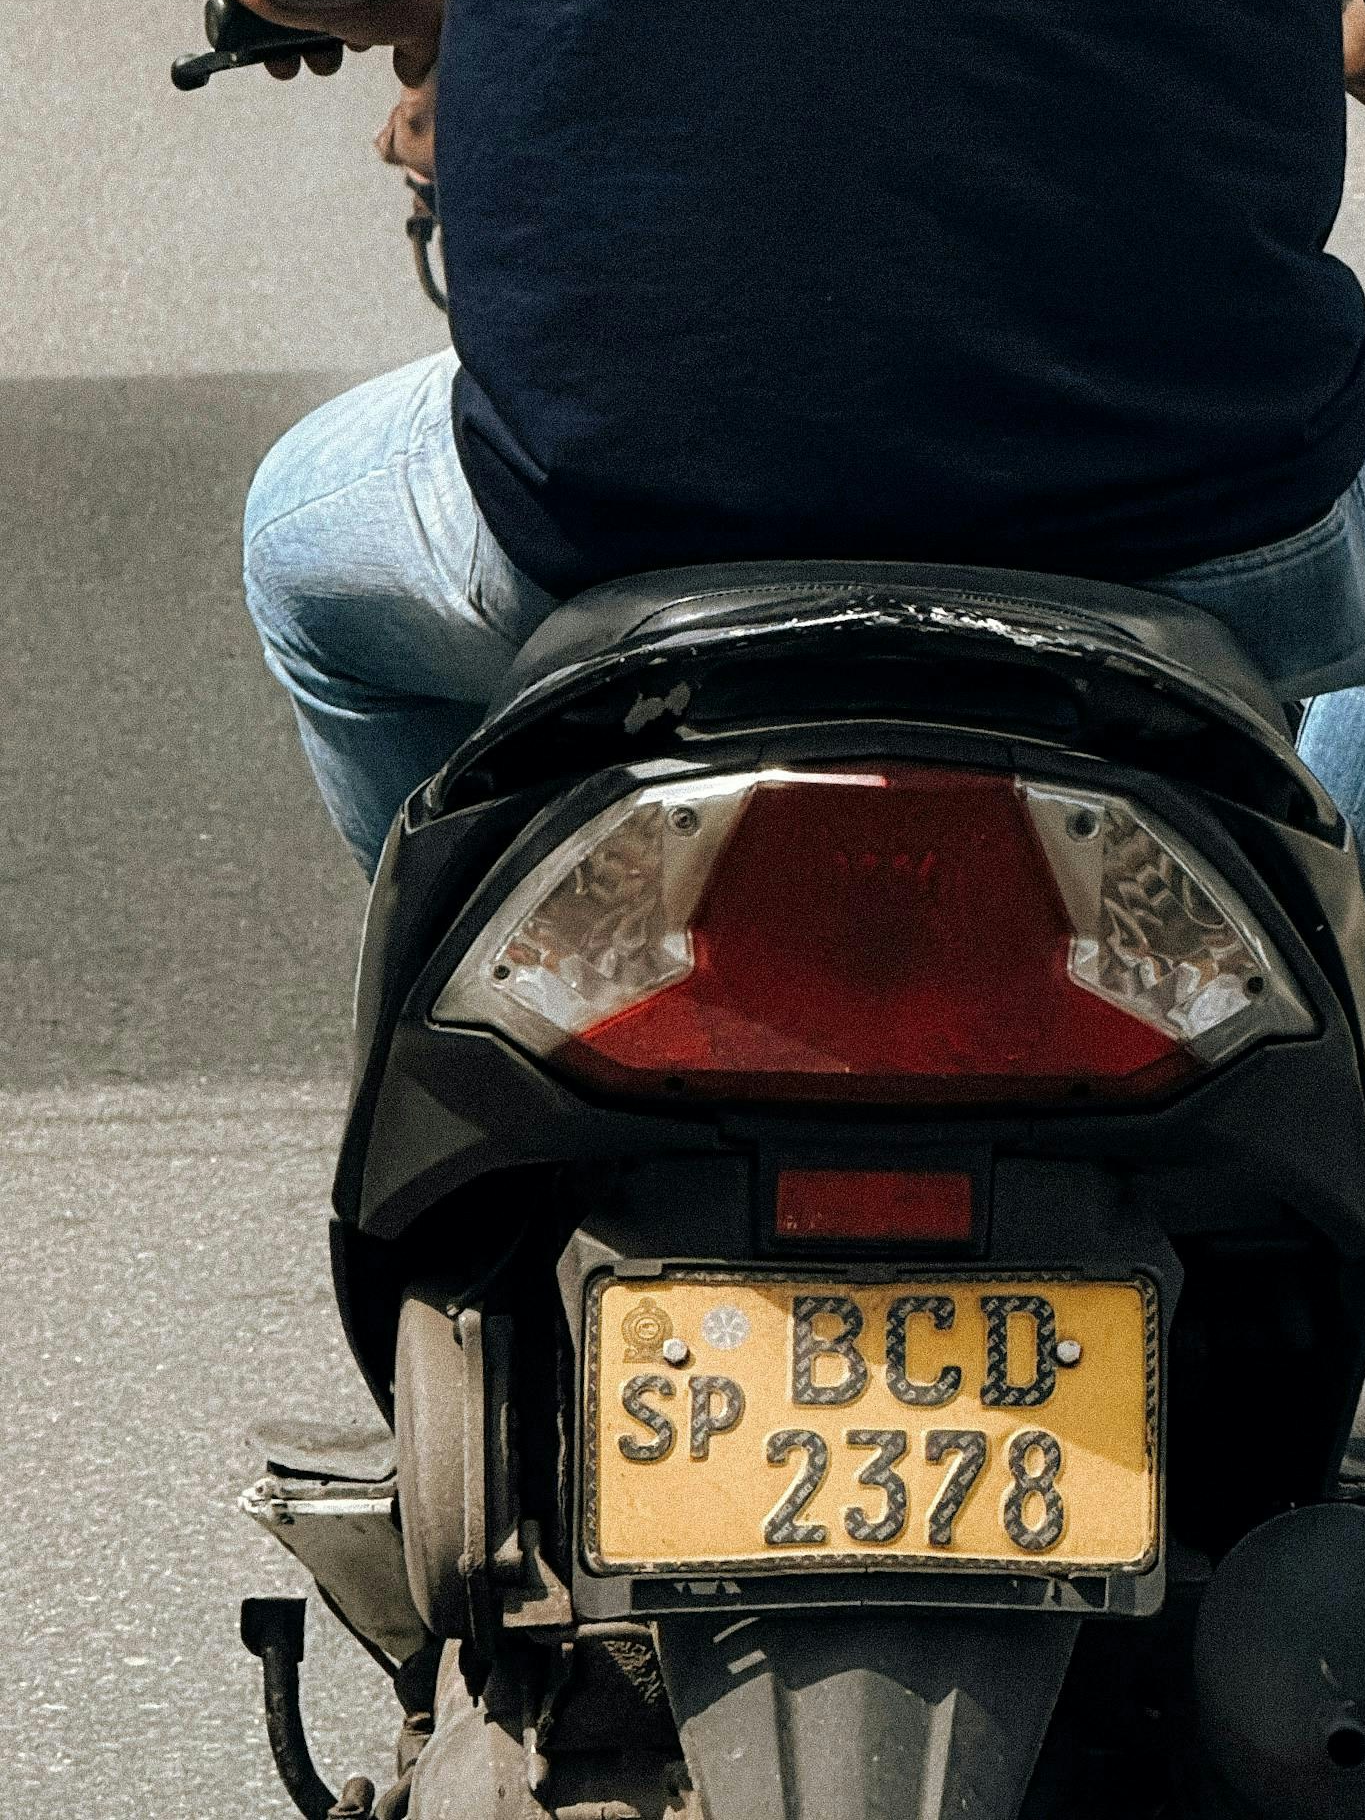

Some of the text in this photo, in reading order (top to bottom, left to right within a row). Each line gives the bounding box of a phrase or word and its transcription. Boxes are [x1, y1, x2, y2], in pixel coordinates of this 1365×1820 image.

[791, 1295, 1057, 1407] BCD
[617, 1374, 746, 1464] SP
[764, 1429, 1066, 1551] 2378
